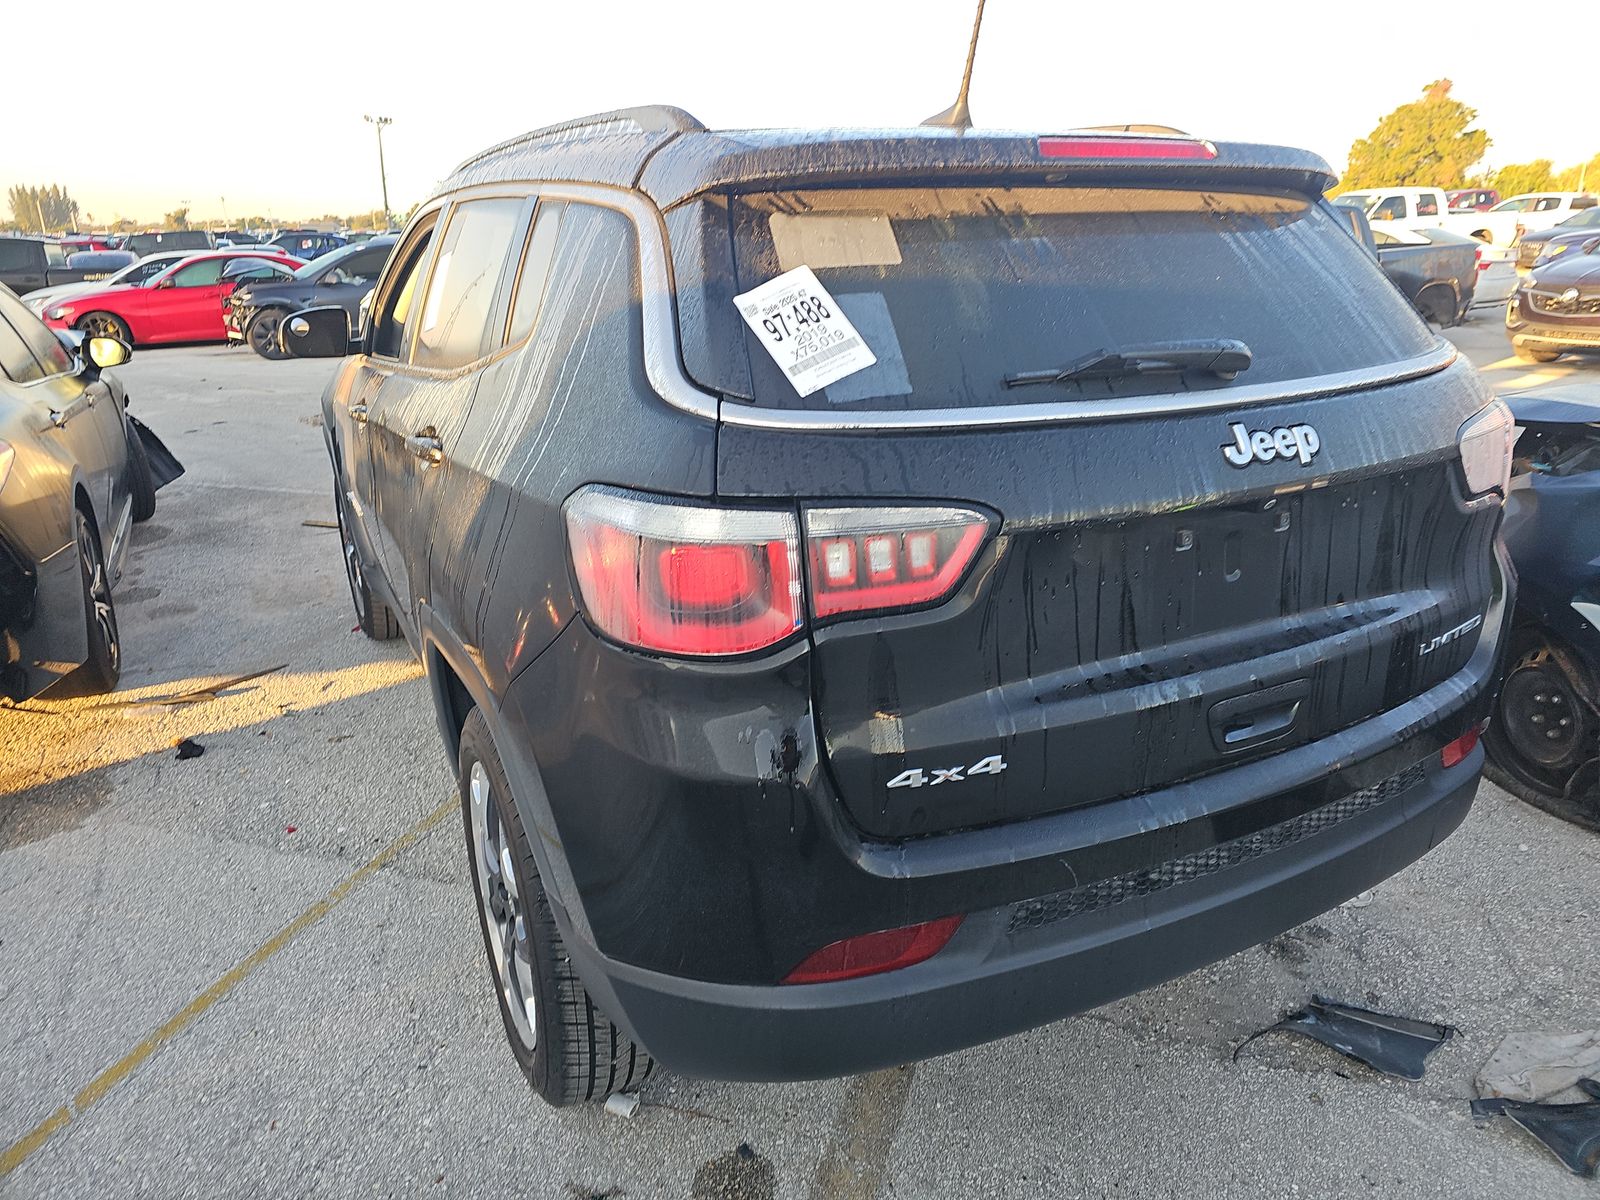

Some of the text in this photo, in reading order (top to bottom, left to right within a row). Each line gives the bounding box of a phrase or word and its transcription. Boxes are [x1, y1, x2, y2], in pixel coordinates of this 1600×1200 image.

[1223, 422, 1320, 466] Jeep
[1419, 614, 1482, 656] LIMITED
[886, 754, 1007, 789] 4x4
